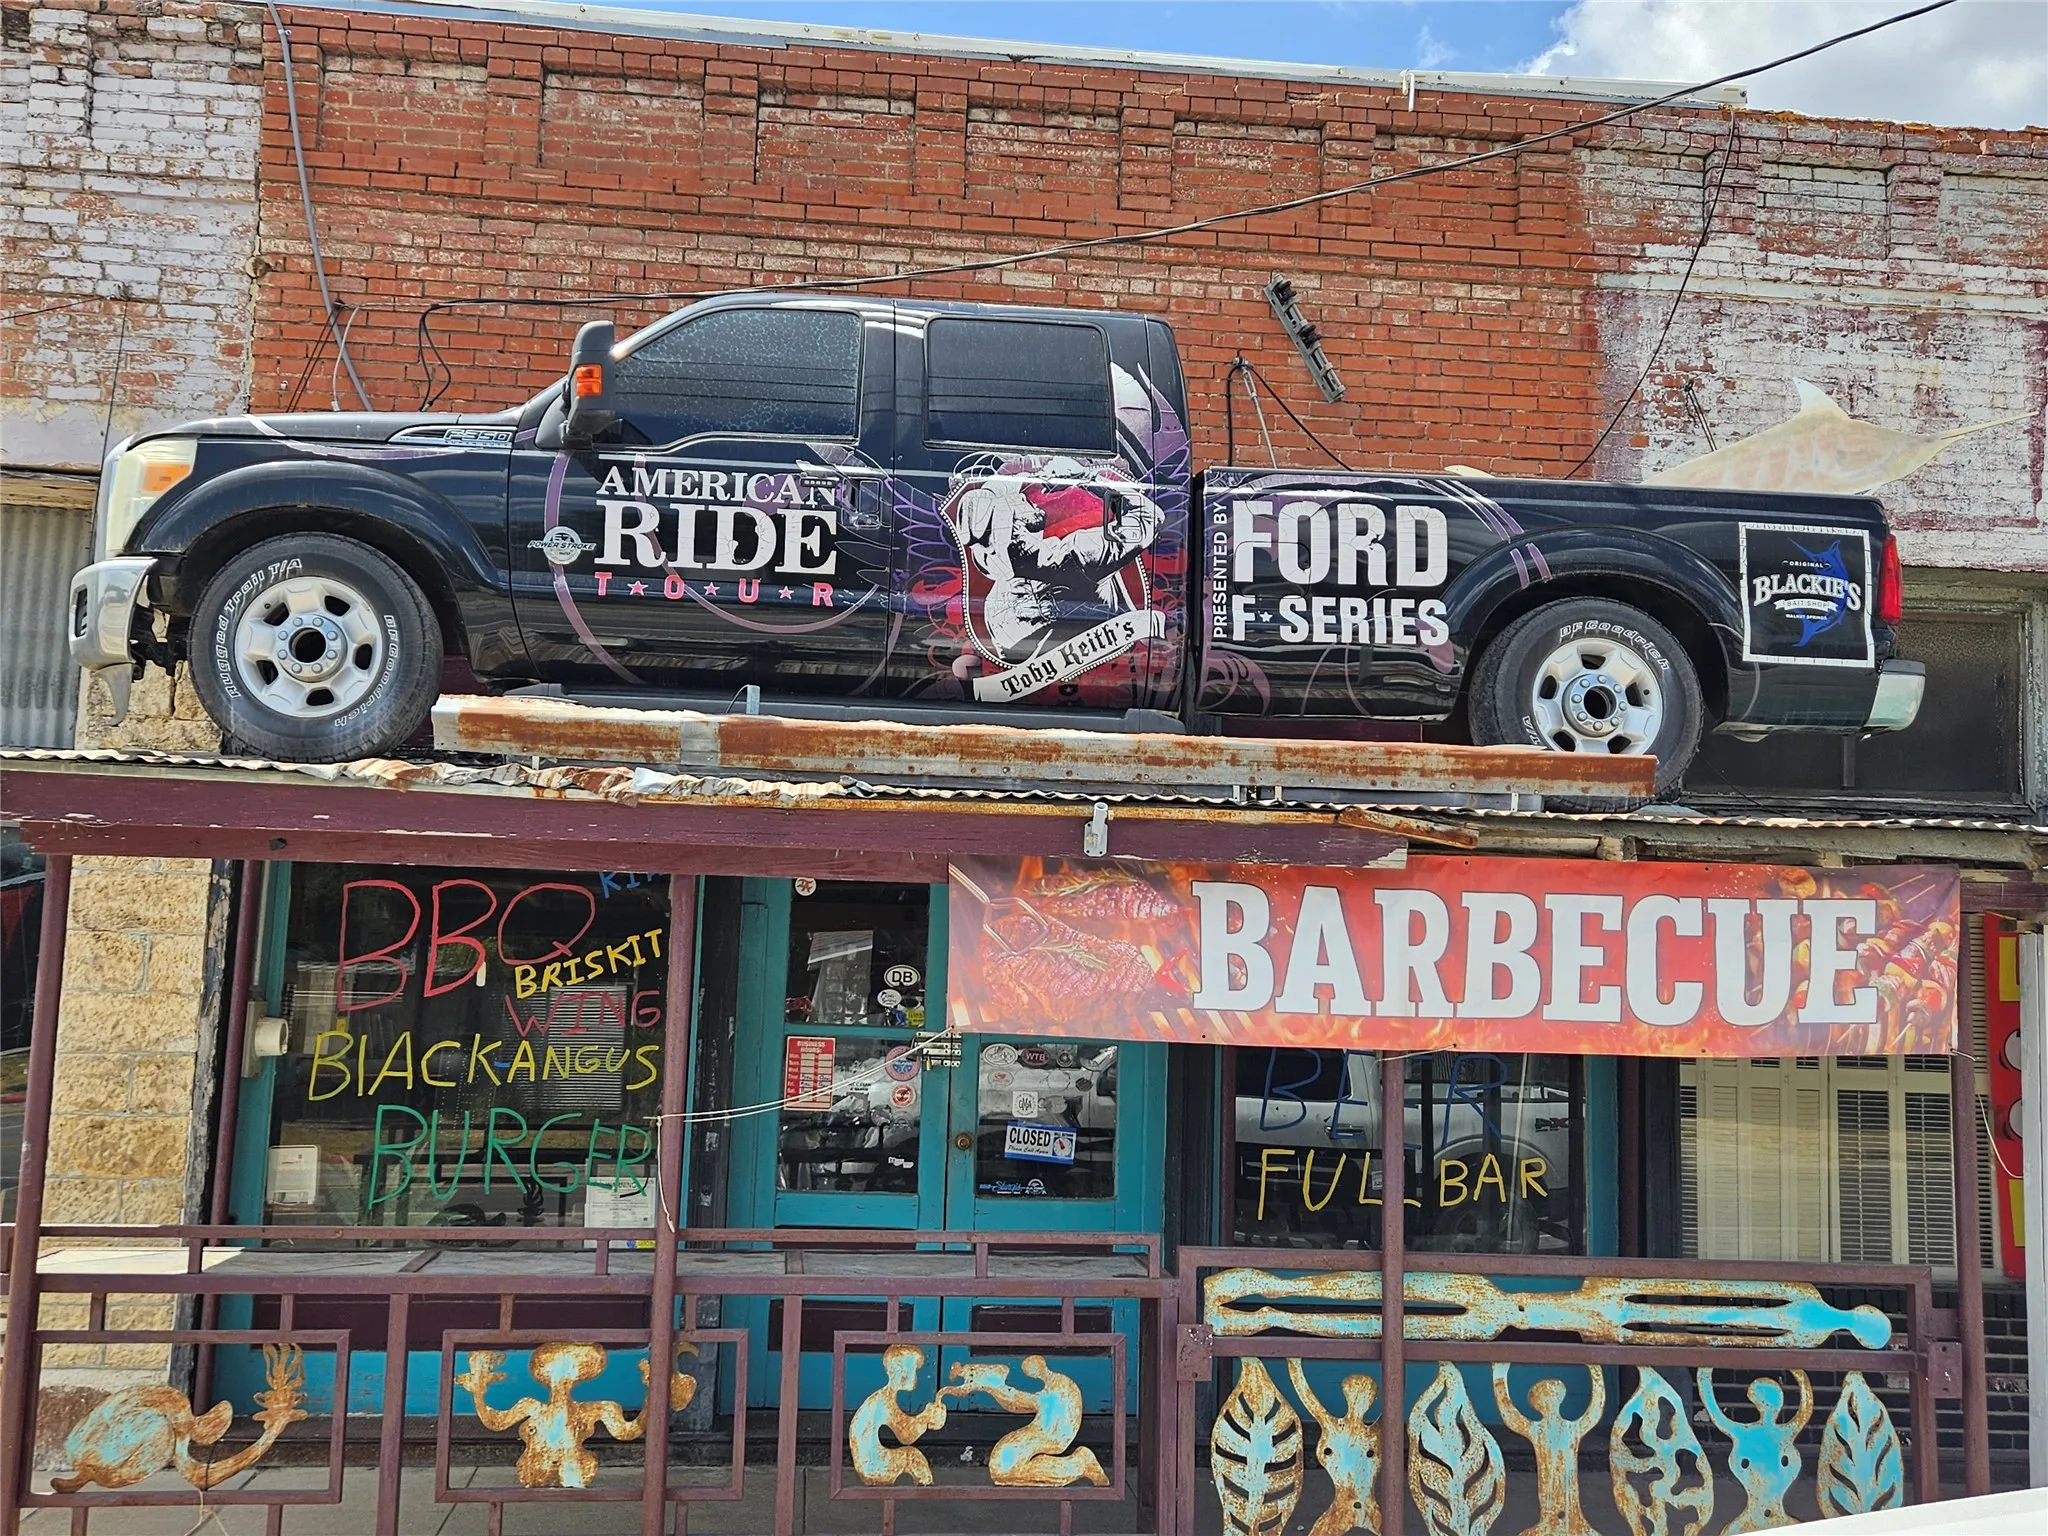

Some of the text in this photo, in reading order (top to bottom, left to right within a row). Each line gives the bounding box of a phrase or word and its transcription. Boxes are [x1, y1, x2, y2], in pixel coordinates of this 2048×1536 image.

[444, 428, 513, 442] F350
[595, 465, 836, 507] AMERICAN
[528, 540, 596, 551] POWER STROKE
[594, 499, 837, 575] RIDE
[1232, 500, 1448, 587] FORD
[1213, 501, 1228, 638] PRESENTED BY
[1752, 573, 1862, 611] BLACKIE'S
[215, 558, 302, 698] Rugged Trail T/A
[1279, 594, 1450, 646] SERIES
[1807, 600, 1827, 608] SHOP
[334, 614, 399, 727] BFGoodrich
[1000, 620, 1135, 697] Toby Keith's
[1559, 619, 1671, 671] BFGoodrich
[337, 879, 596, 1013] BBQ
[514, 928, 663, 999] BRISKIT
[891, 970, 913, 983] DB
[1191, 881, 1879, 1027] BARBECUE
[505, 990, 661, 1037] WING
[1025, 1052, 1046, 1061] WTB
[369, 1104, 652, 1209] BURGER
[1009, 1127, 1051, 1147] CLOSED
[1258, 1149, 1548, 1220] FUL BAR
